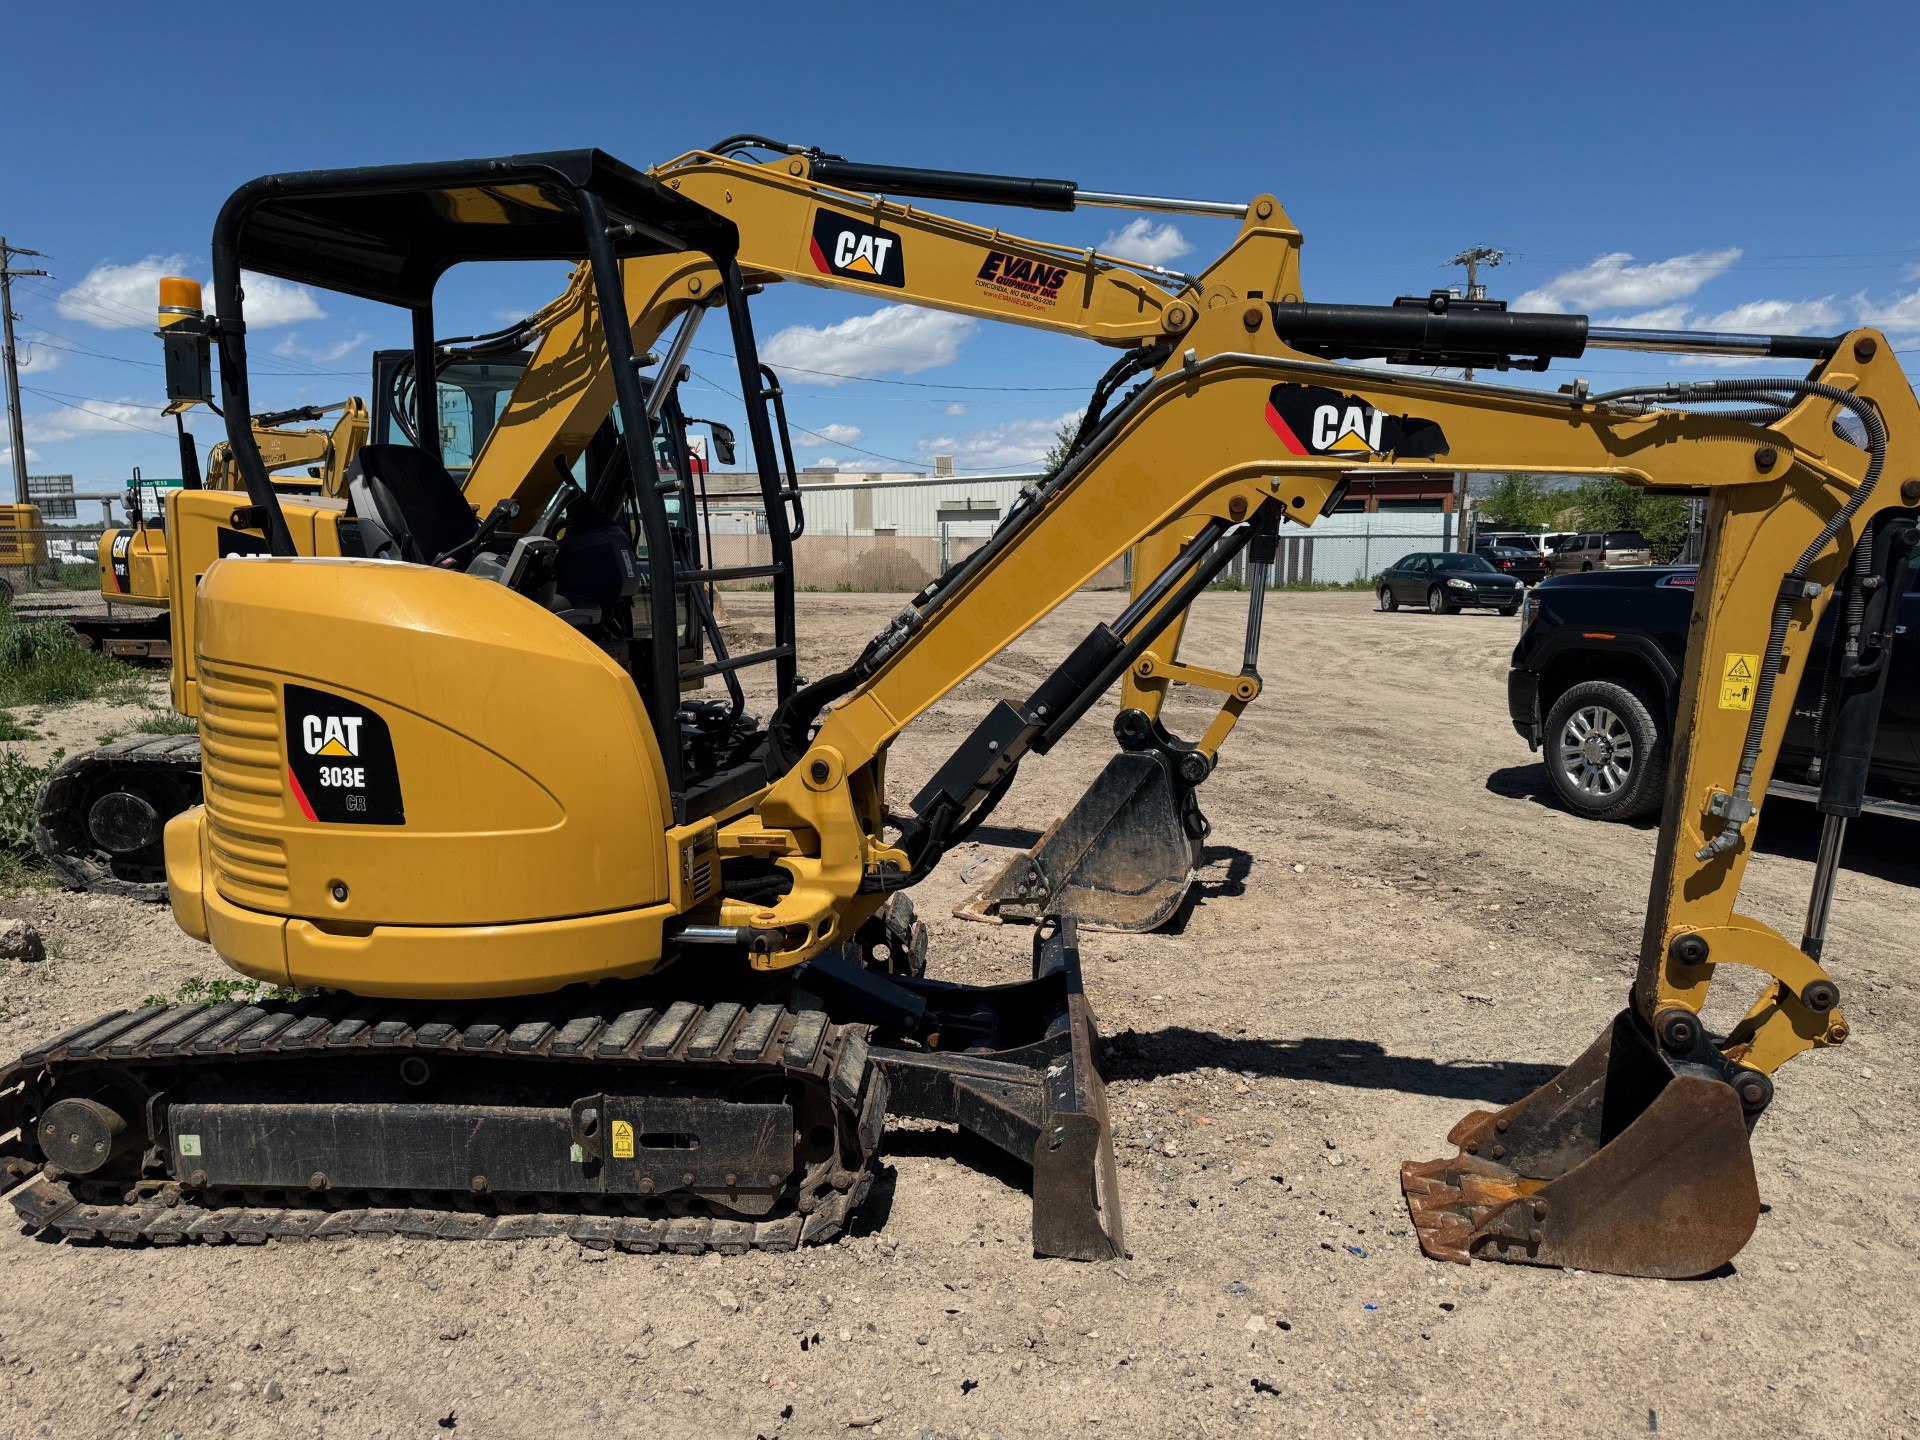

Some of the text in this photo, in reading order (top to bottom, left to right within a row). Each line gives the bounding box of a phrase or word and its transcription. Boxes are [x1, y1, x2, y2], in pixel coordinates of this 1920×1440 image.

[834, 230, 892, 275] CAT
[976, 250, 1068, 289] EVANS
[975, 280, 1008, 294] CONCORDIA,
[1010, 289, 1019, 297] MO
[1040, 287, 1058, 300] INC.
[1312, 405, 1389, 451] CAT
[113, 536, 131, 558] CAT
[303, 714, 363, 757] CAT
[320, 766, 366, 788] 303E
[345, 794, 367, 812] CR
